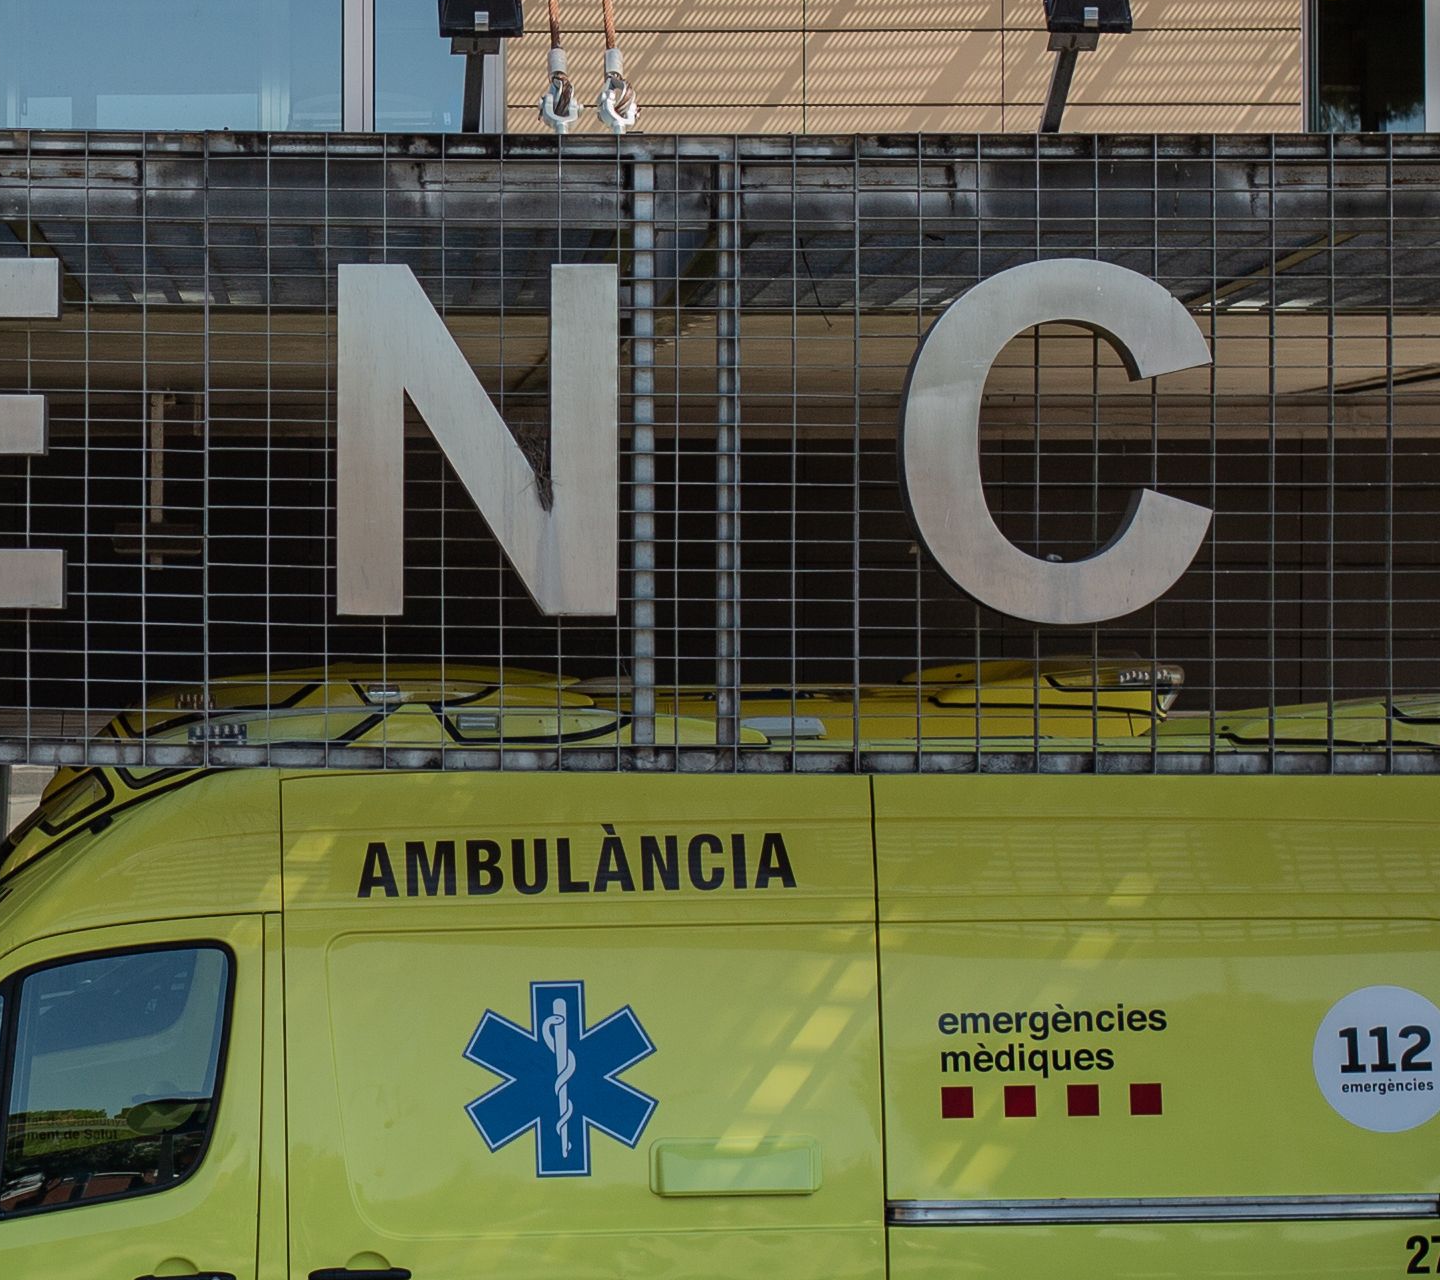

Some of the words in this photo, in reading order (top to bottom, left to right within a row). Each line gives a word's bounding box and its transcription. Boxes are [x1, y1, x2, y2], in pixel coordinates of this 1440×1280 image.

[356, 823, 798, 899] AMBULÀNCIA
[937, 1002, 1168, 1041] emergències
[940, 1043, 1115, 1079] mèdiques
[1338, 1025, 1433, 1073] 112
[1341, 1078, 1434, 1095] emergències
